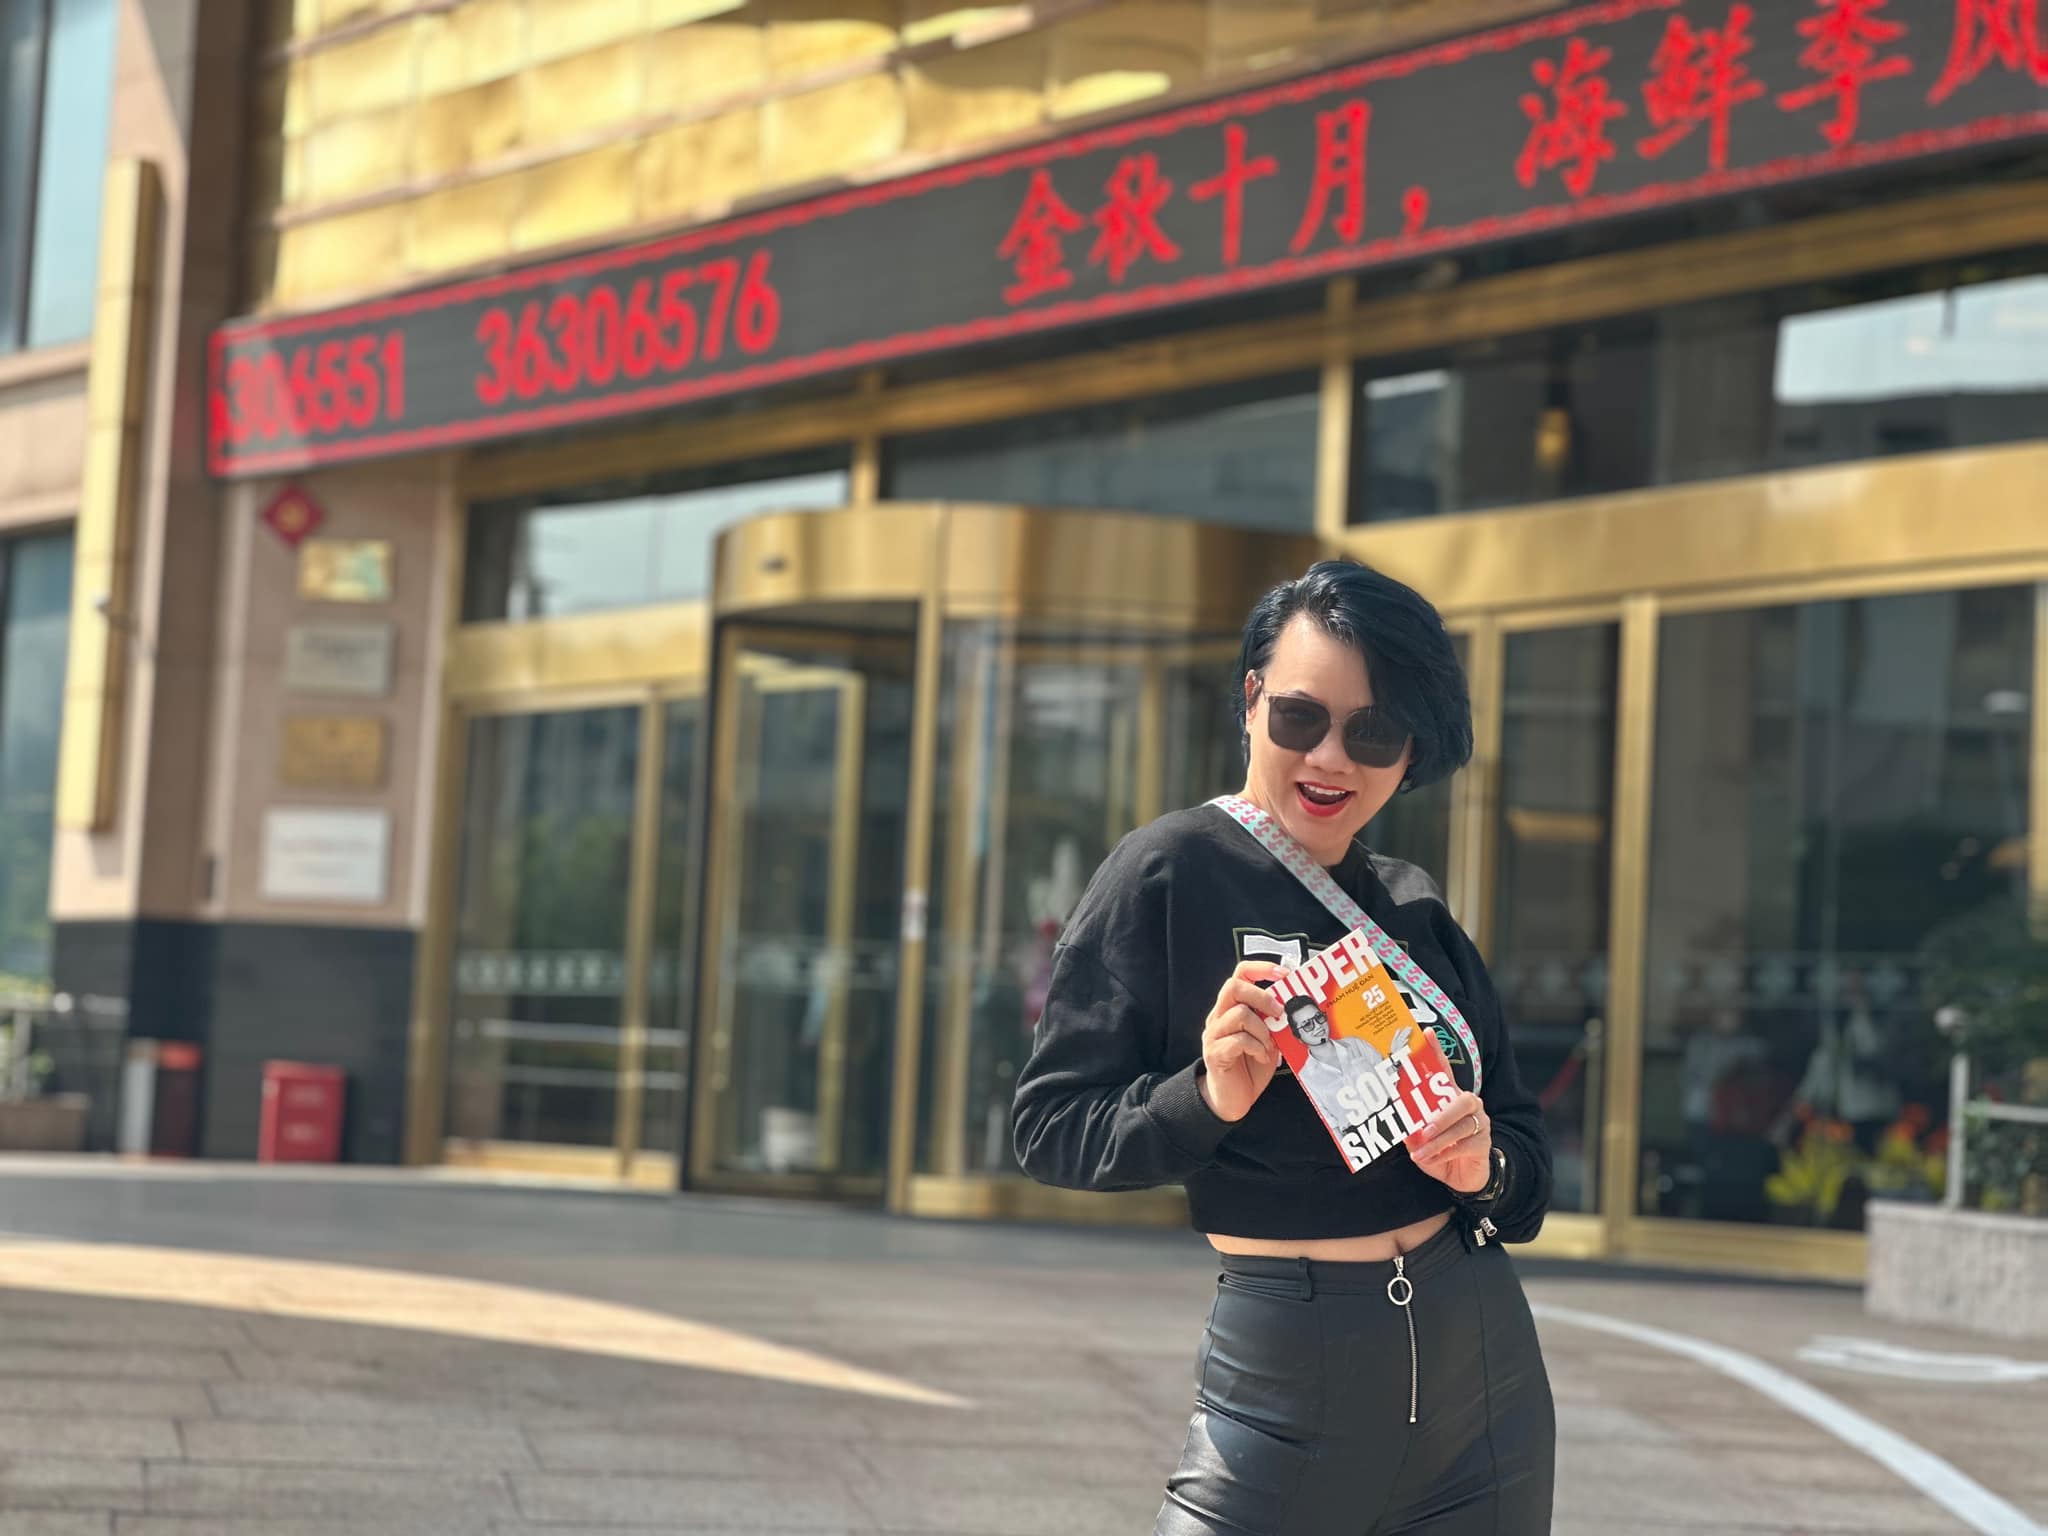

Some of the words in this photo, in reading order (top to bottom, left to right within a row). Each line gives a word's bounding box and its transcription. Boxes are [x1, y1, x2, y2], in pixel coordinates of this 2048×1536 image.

[475, 249, 780, 406] 36306576
[1361, 983, 1386, 1009] 25
[1336, 1045, 1422, 1126] SOFT
[1341, 1071, 1458, 1173] SKILLS
